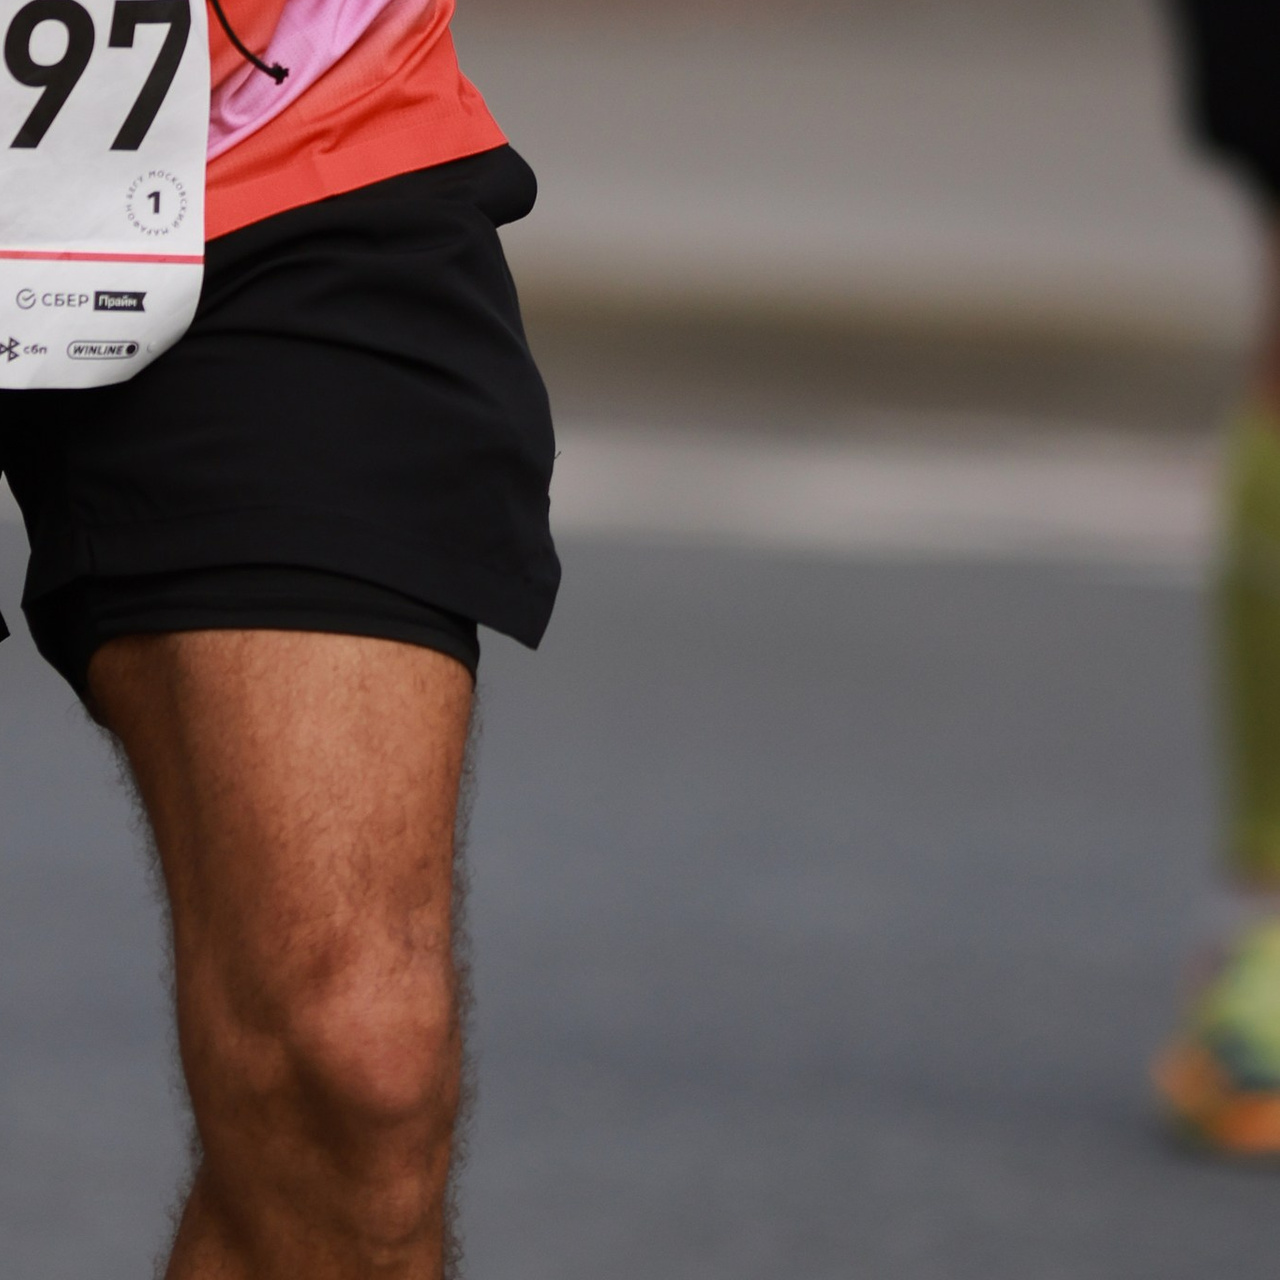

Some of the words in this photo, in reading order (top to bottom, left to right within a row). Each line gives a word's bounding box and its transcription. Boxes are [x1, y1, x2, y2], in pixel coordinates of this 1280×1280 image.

[147, 190, 160, 214] 1
[41, 293, 89, 307] СБЕР
[98, 293, 138, 308] Прайм
[73, 345, 125, 355] WINLINE
